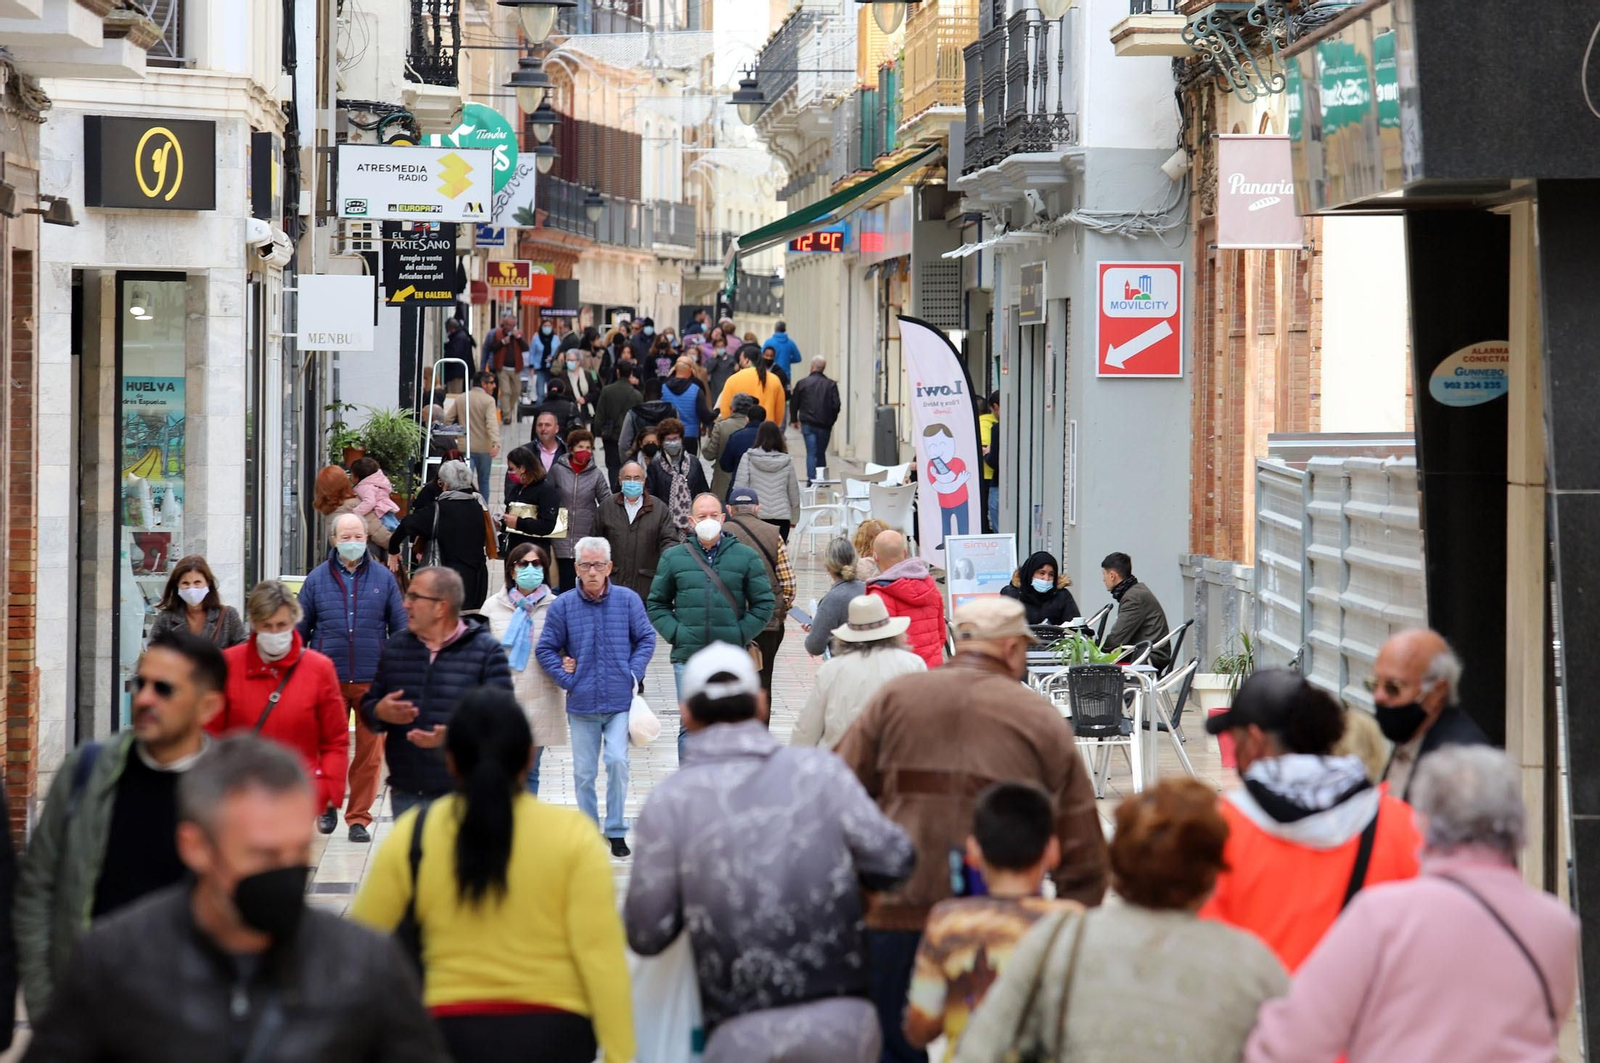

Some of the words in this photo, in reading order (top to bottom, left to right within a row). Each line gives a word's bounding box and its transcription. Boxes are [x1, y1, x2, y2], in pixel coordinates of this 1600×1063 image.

[476, 127, 507, 139] Tiendas
[357, 163, 427, 173] ATRESMEDIA
[398, 174, 428, 182] RADIO
[392, 231, 404, 240] EL
[797, 233, 813, 251] 12
[400, 254, 421, 262] Arreglo
[405, 263, 415, 271] del
[416, 263, 437, 271] calzado
[432, 273, 444, 281] piel
[488, 277, 528, 287] TABACOS
[414, 291, 424, 299] EN
[425, 291, 452, 299] GALERIA
[1110, 301, 1169, 310] MOVILCITY
[308, 332, 358, 344] MENBU
[126, 381, 175, 392] HUELVA
[963, 541, 998, 550] simyo
